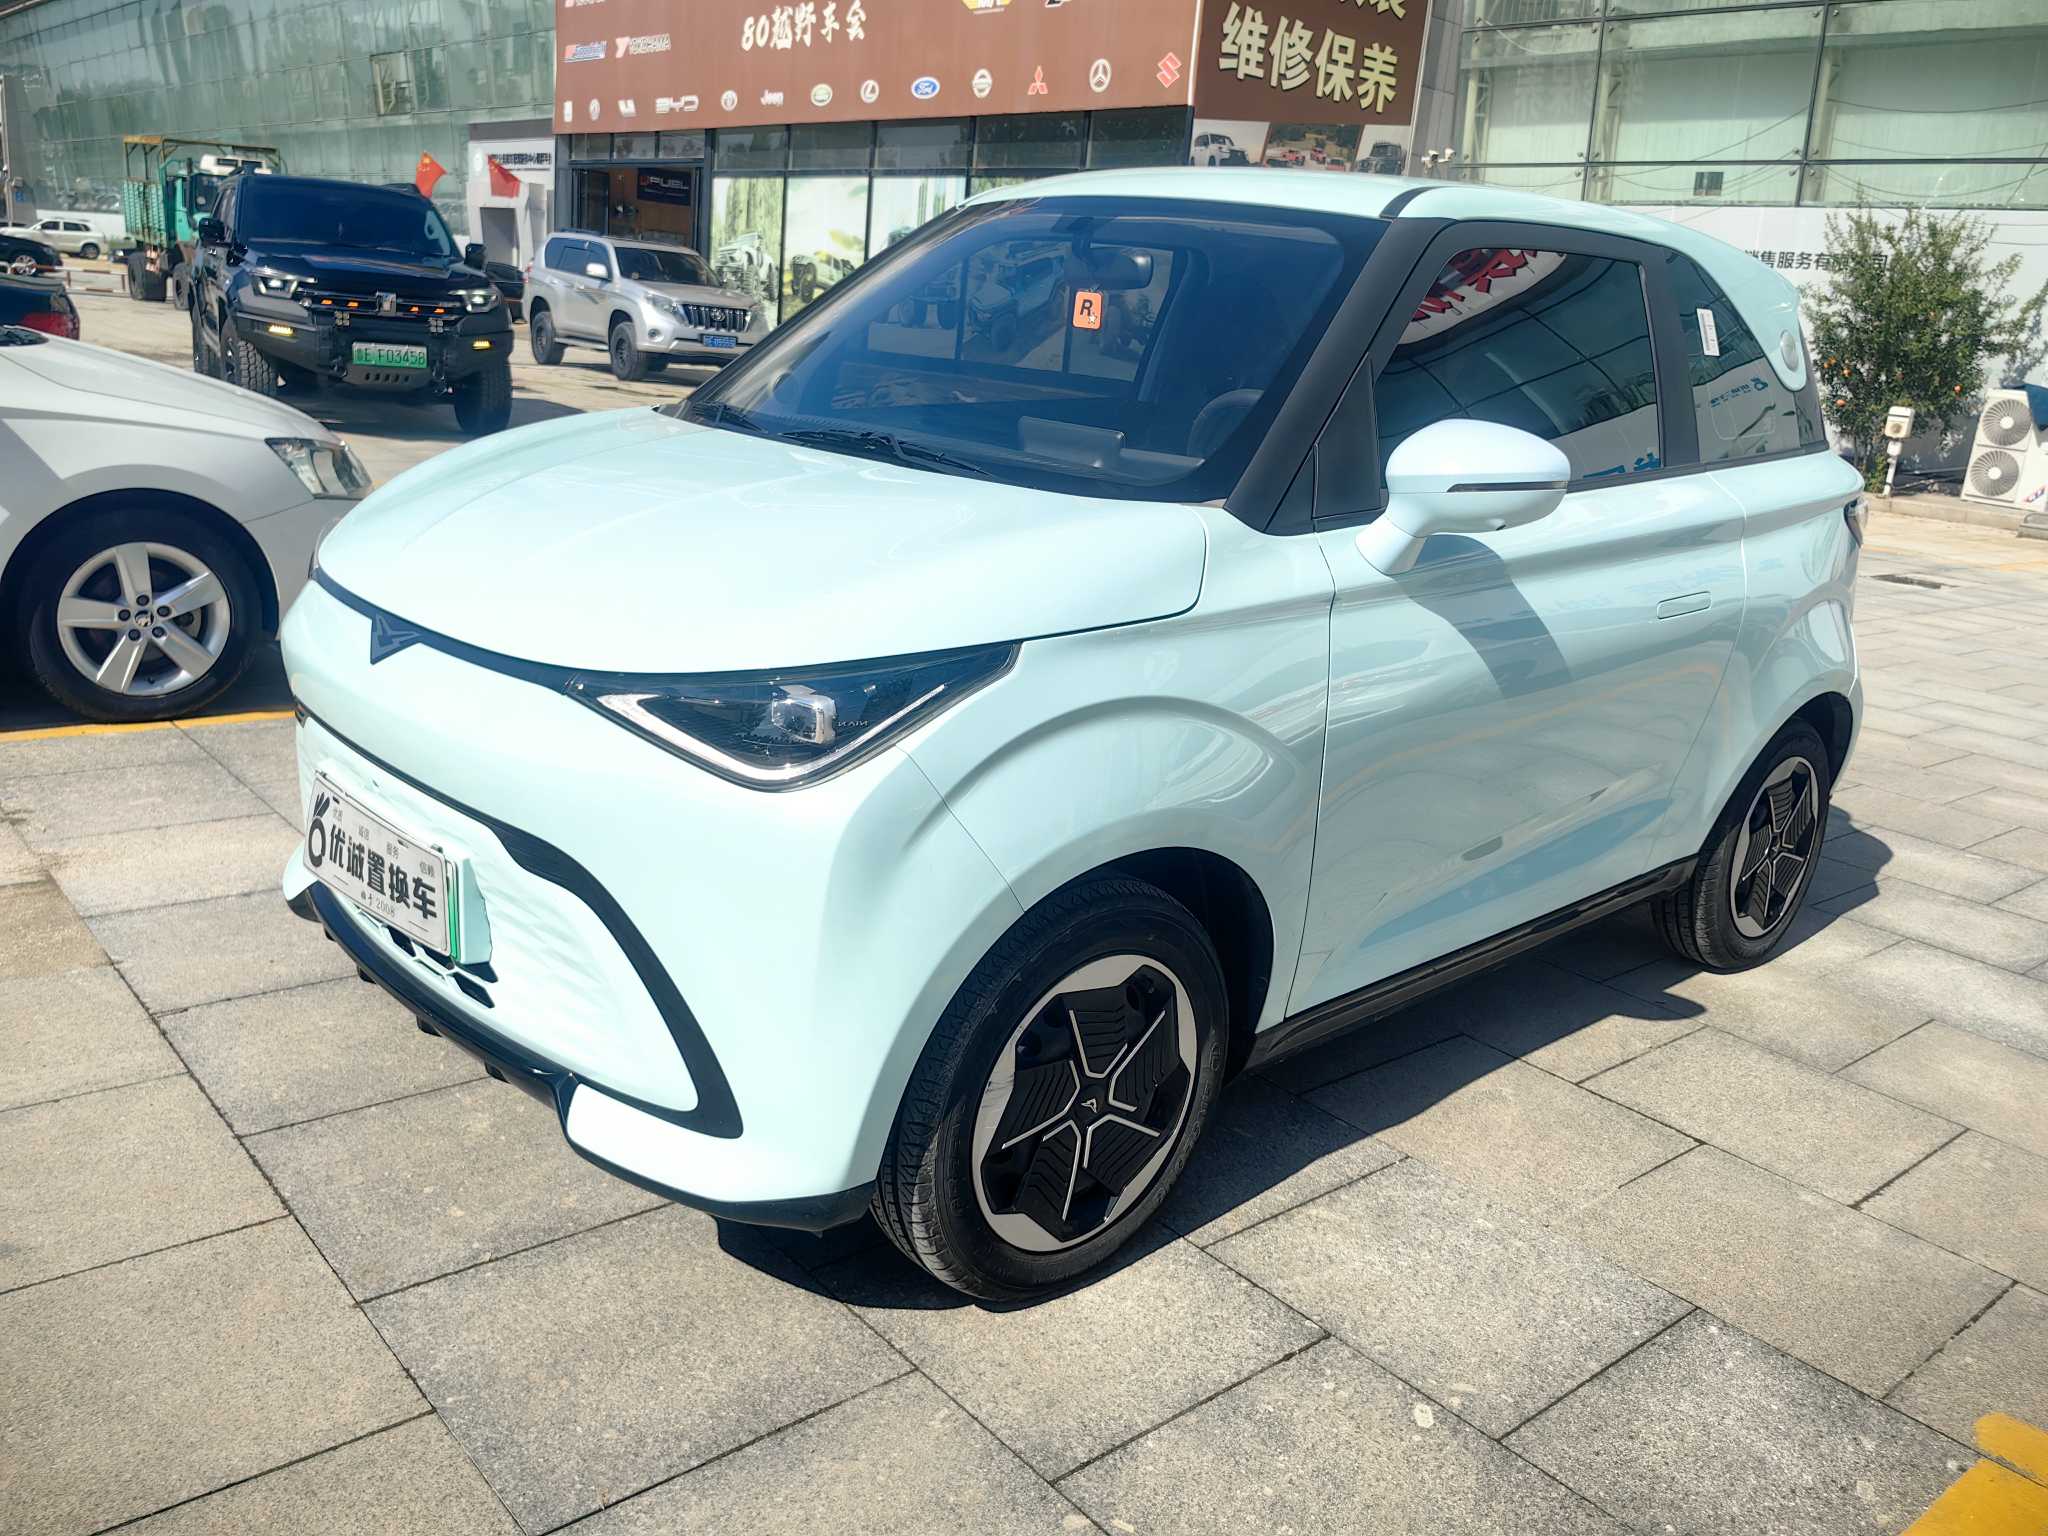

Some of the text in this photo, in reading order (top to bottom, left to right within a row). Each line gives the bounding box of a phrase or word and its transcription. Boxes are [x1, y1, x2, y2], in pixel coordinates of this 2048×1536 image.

[1218, 2, 1399, 114] 维修保养
[329, 823, 438, 919] 优诚置换车
